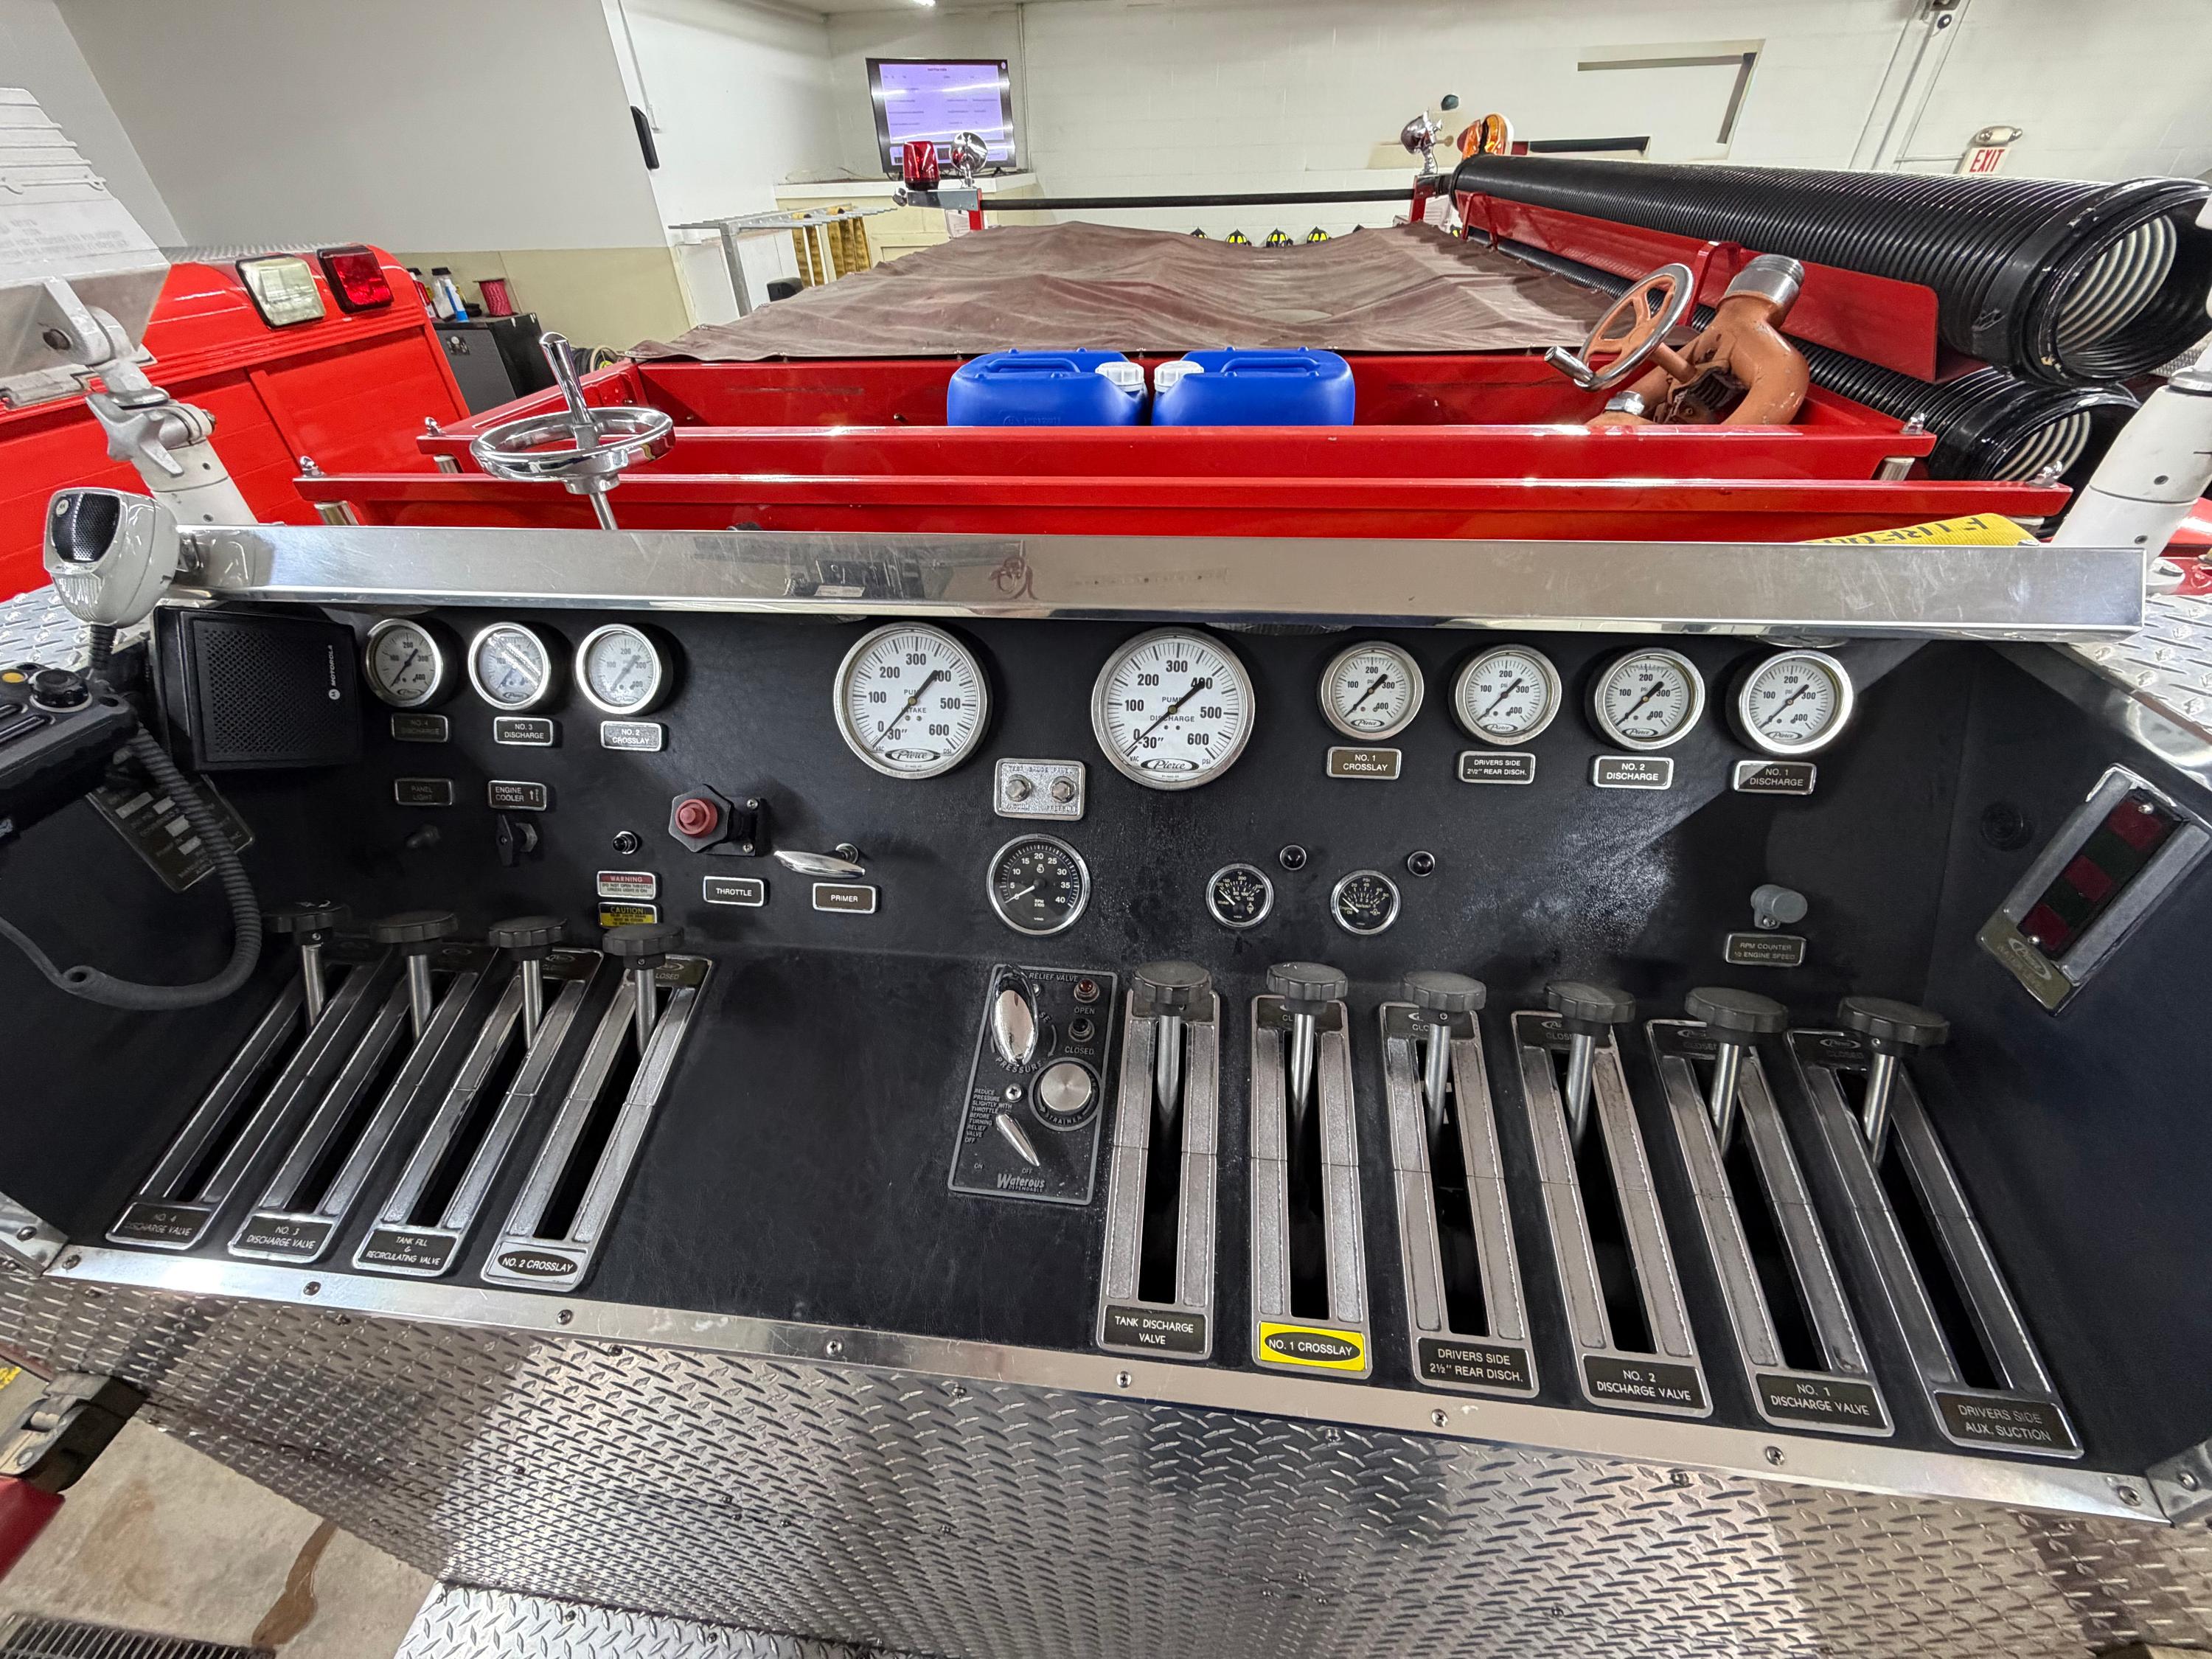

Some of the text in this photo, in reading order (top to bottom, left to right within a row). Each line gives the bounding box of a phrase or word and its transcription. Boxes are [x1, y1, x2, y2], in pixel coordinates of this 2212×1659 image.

[1969, 149, 2006, 173] EXIT
[327, 644, 337, 686] MOTOROLA
[905, 653, 927, 665] 300
[1166, 660, 1188, 672] 300
[880, 667, 900, 678] 200
[1137, 674, 1159, 686] 200
[1382, 681, 1395, 689] 300
[869, 692, 886, 703] 100
[1619, 689, 1632, 697] 100
[1763, 691, 1775, 699] 100
[1801, 692, 1816, 700] 300
[940, 698, 961, 709] 500
[1125, 700, 1144, 712] 100
[1200, 706, 1222, 718] 500
[877, 720, 885, 732] 0
[928, 724, 950, 736] 600
[504, 731, 544, 740] DISCHARGE
[1133, 728, 1140, 740] 0
[1187, 733, 1209, 745] 600
[1153, 759, 1186, 770] Pierce
[1343, 763, 1388, 771] CROSSLAY
[1607, 772, 1659, 781] DISCHARGE
[1750, 777, 1804, 787] DISCHARGE
[495, 786, 522, 795] ENGINE
[495, 794, 525, 802] COOLER
[716, 887, 752, 897] THROTTLE
[830, 894, 858, 902] PRIMER
[655, 972, 680, 980] LOSED
[1029, 972, 1079, 982] RELIEF VALVE
[1064, 1046, 1094, 1055] CLOSED
[995, 1056, 1043, 1074] PRESSURE
[997, 1173, 1046, 1189] Waterous
[1008, 1185, 1043, 1193] DEPENDABLE
[168, 1225, 192, 1236] VALVE
[274, 1226, 300, 1236] NO. 3
[246, 1234, 316, 1249] DISCHARGE VALVE
[396, 1237, 428, 1247] TANK FILL
[366, 1251, 441, 1265] RECIRCULATING VALVE
[501, 1257, 574, 1272] NO. 2 CROSSLAY
[1115, 1315, 1194, 1333] TANK DISCHARGE
[1138, 1332, 1166, 1345] VALVE
[1268, 1339, 1352, 1356] NO. 1 CROSSLAY
[1438, 1348, 1511, 1365] DRIVERS SIDE
[1455, 1366, 1484, 1378] REAR
[1486, 1368, 1523, 1382] DISCH.
[1623, 1369, 1656, 1382] NO. 2
[1597, 1381, 1691, 1401] DISCHARGE VALVE
[1796, 1383, 1831, 1397] NO. 1
[1770, 1395, 1870, 1416] DISCHARGE VALVE
[1958, 1405, 2042, 1425] DRIVERS SIDE
[1966, 1422, 2052, 1441] AUX. SUCTION
